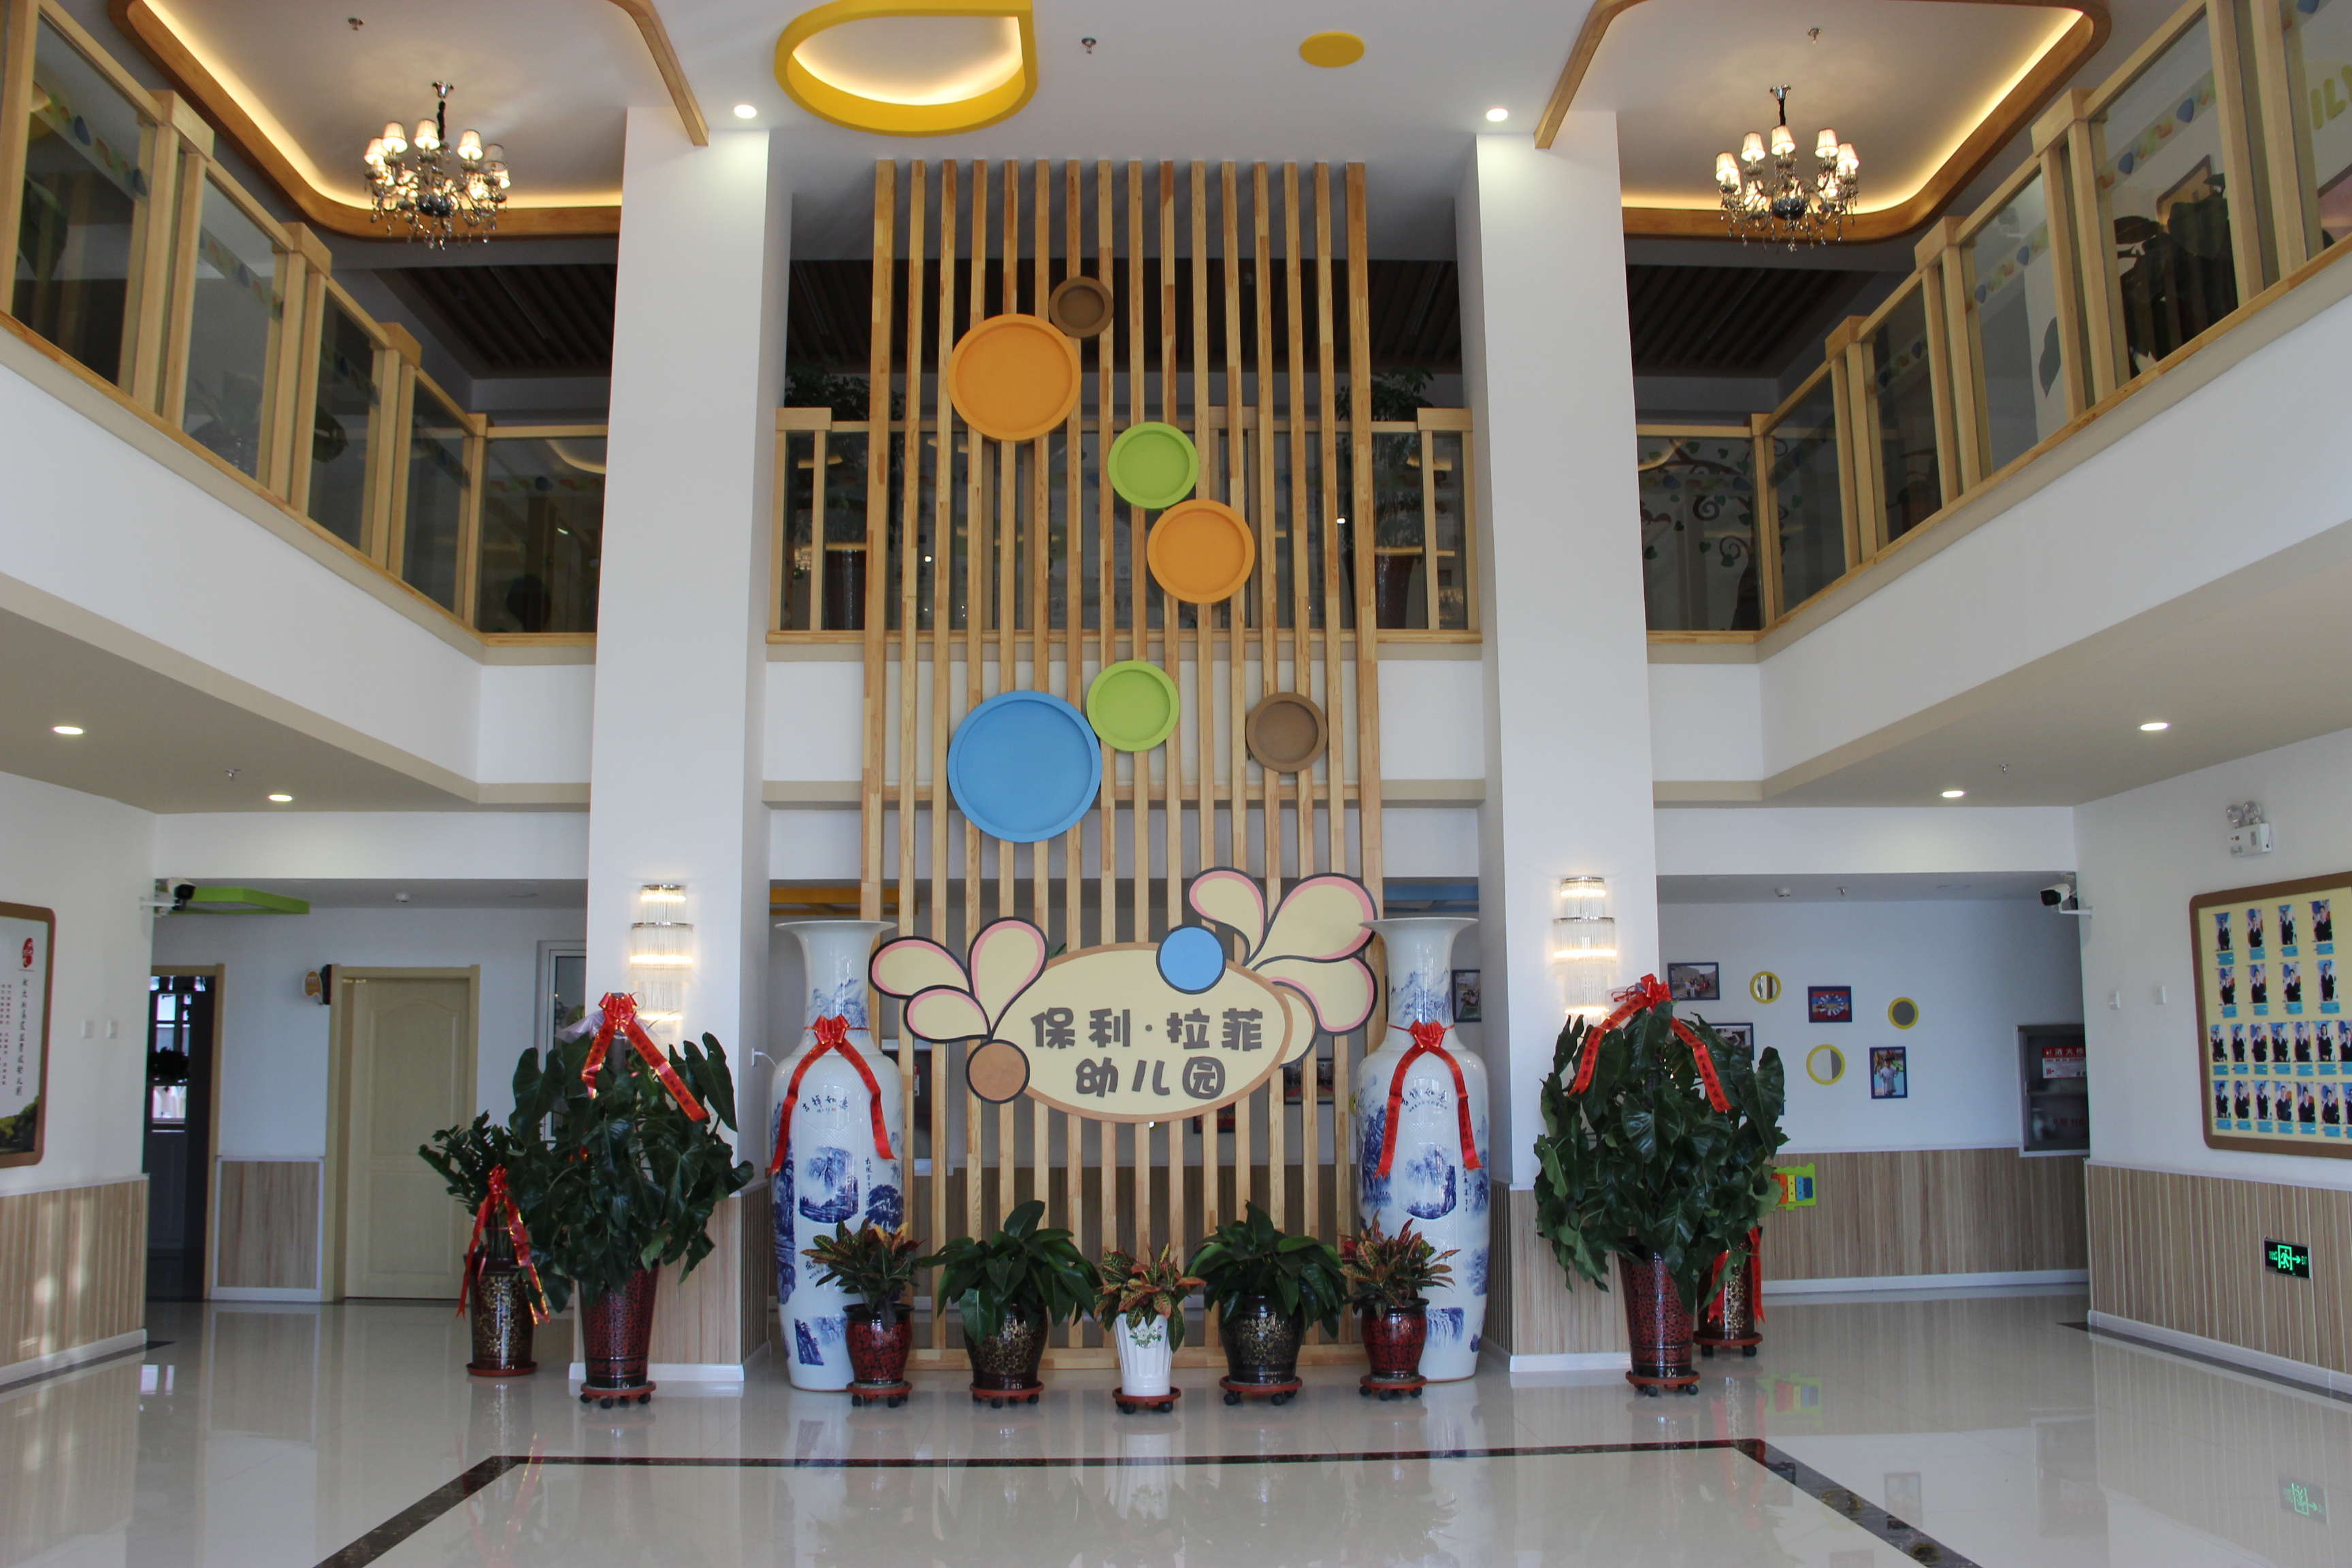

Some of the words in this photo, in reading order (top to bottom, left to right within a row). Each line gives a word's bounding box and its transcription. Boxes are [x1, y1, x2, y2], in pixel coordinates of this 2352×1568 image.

[1030, 1007, 1263, 1051] 保利·拉菲
[1076, 1057, 1226, 1100] 幼儿园
